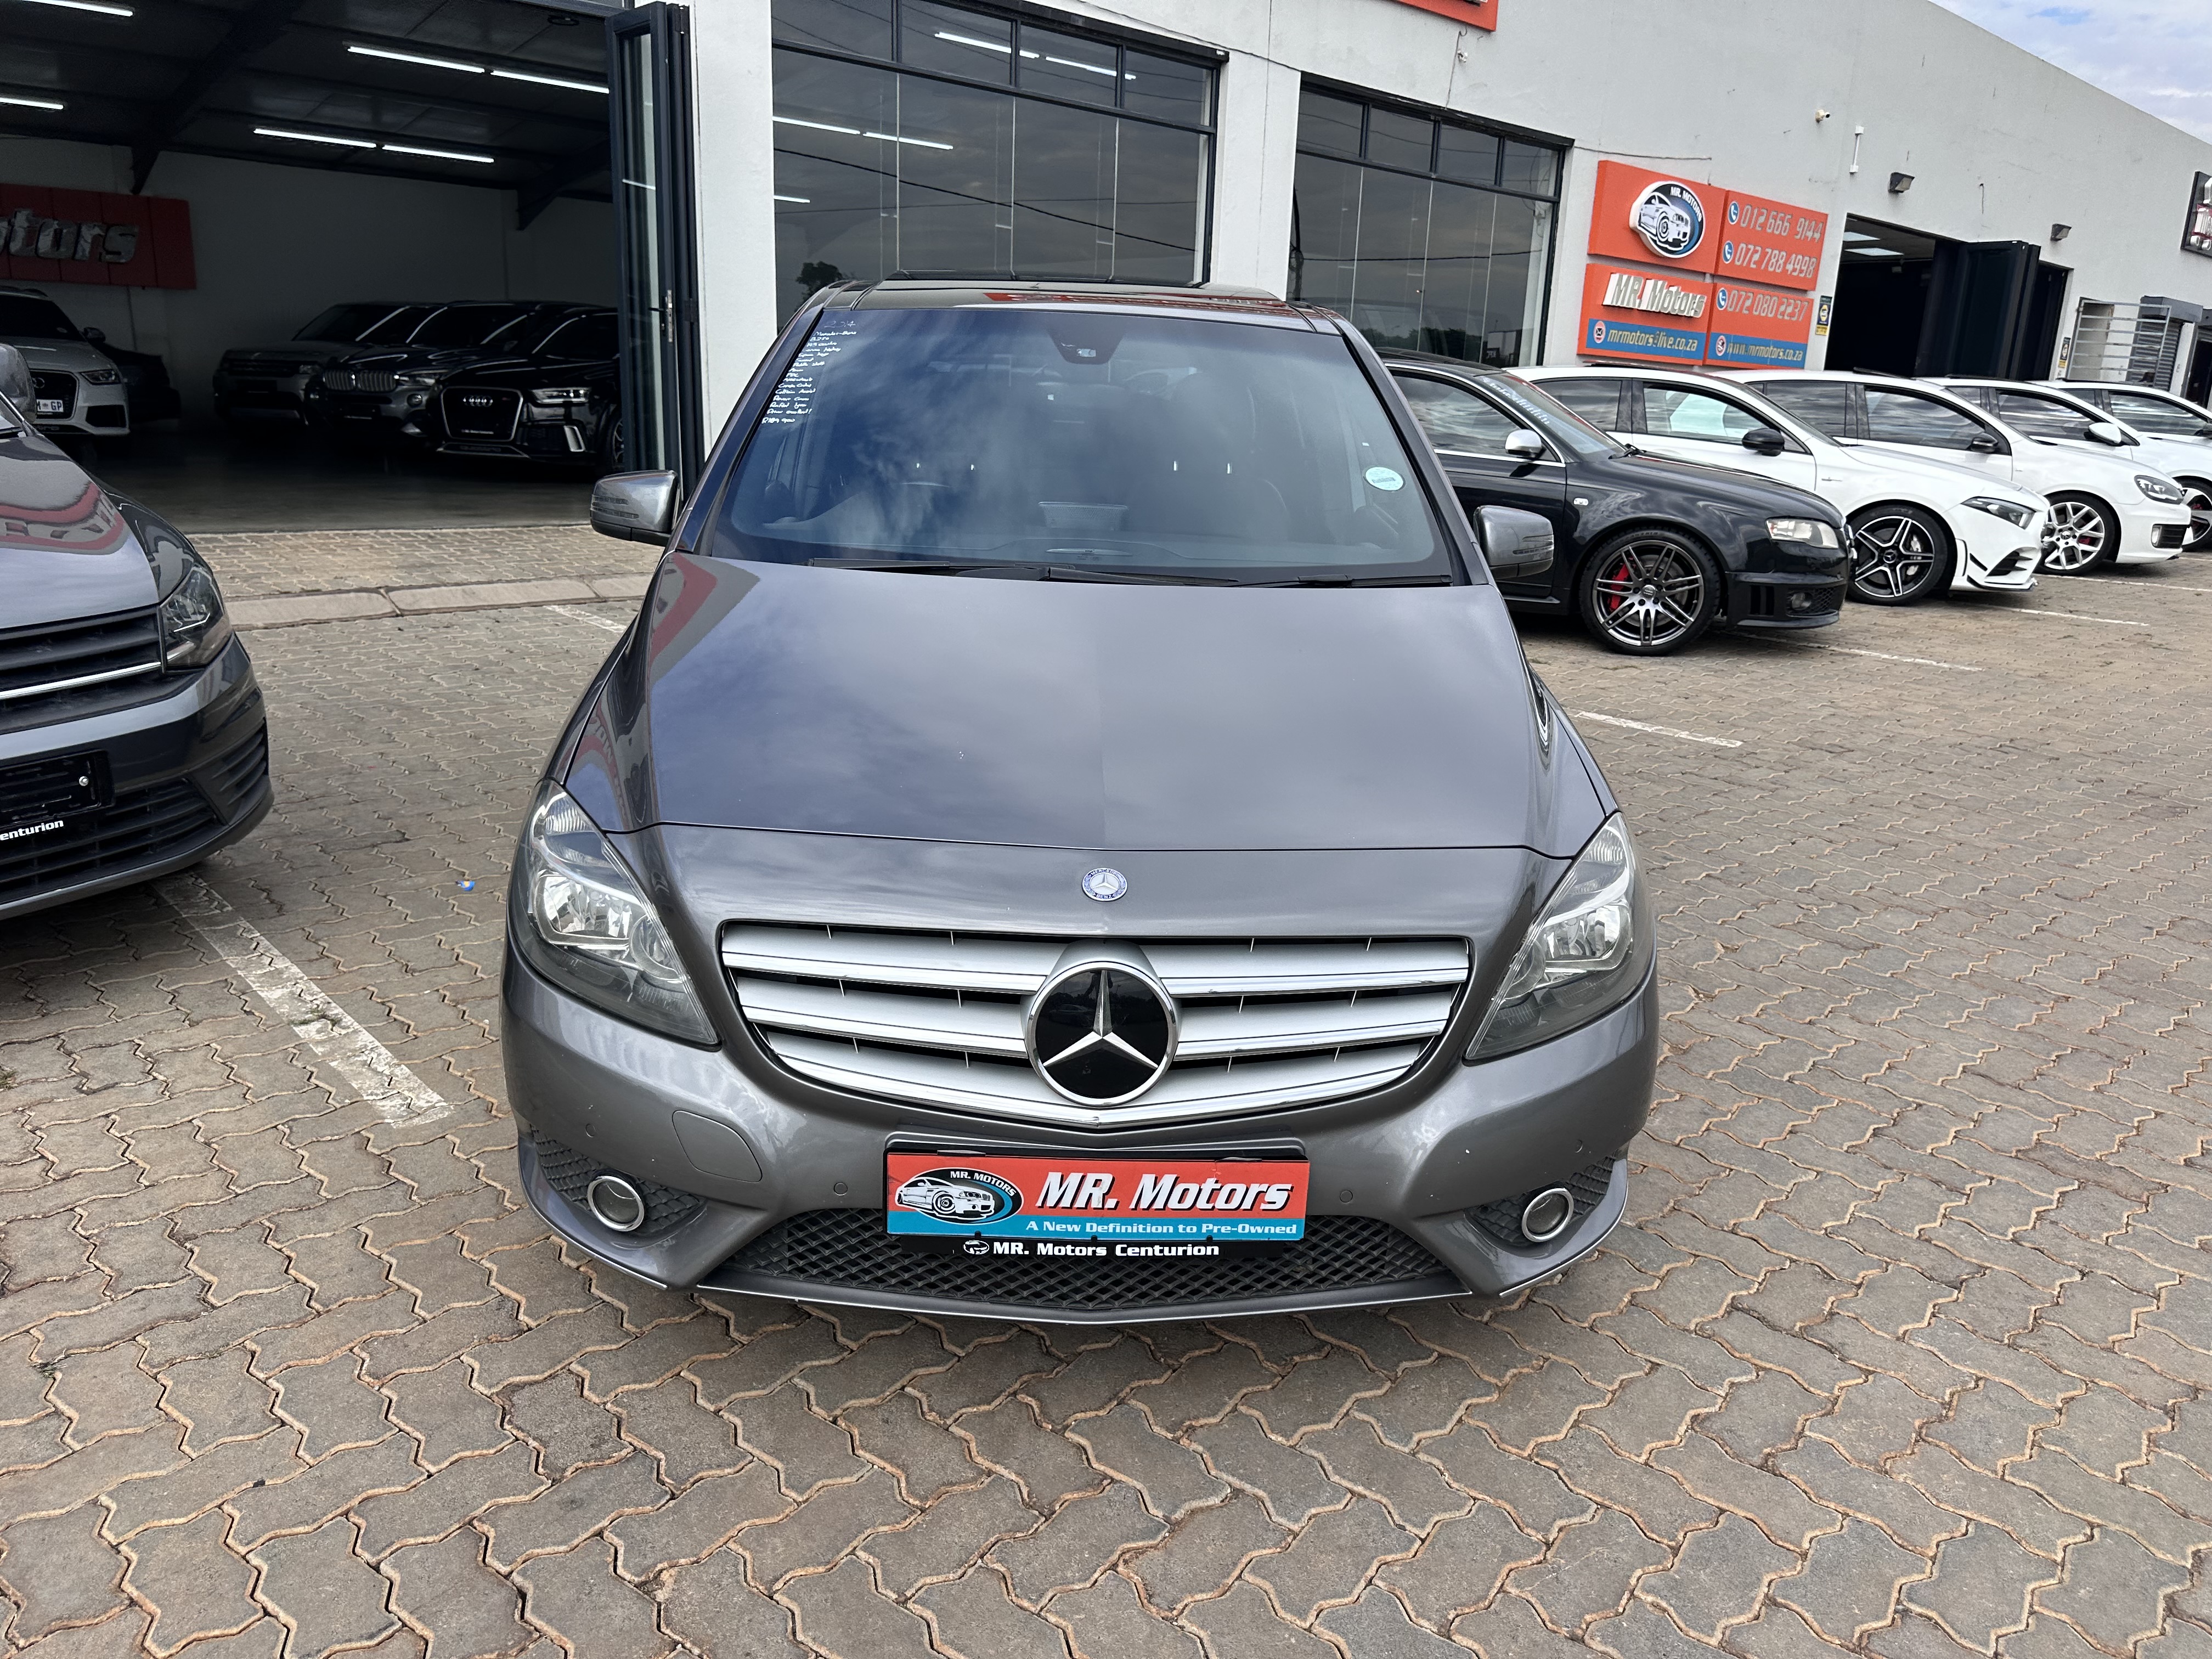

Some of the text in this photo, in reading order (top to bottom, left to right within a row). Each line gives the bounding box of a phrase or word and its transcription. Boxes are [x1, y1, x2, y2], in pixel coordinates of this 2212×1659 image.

[1670, 187, 1702, 222] MR. MOTORS
[1740, 204, 1824, 243] 012 666 9144
[1734, 242, 1818, 279] 072 788 4998
[1603, 274, 1707, 318] MR. Motors
[1726, 289, 1809, 321] 072 080 2237
[1607, 329, 1698, 352] mrmotors@live.co.za
[1726, 342, 1803, 361] www.mrmotors.co.za
[51, 401, 62, 410] GP
[973, 1173, 1016, 1197] MOTORS
[1035, 1172, 1294, 1211] MR. Motors
[1026, 1221, 1297, 1234] A New Definition to Pre-Owned
[992, 1242, 1220, 1256] MR. Motors Centurion
